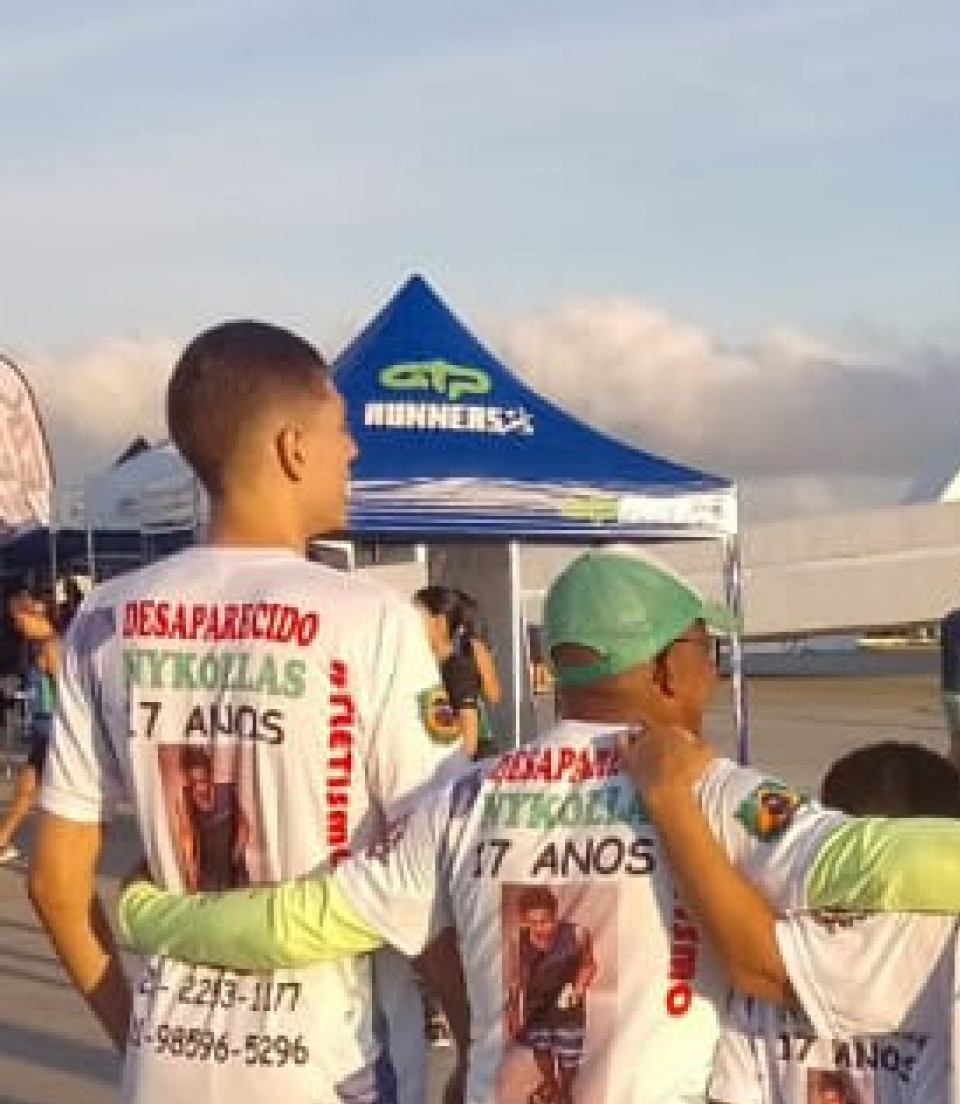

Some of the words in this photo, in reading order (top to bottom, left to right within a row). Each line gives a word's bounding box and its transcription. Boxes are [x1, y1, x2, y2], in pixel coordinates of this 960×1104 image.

[122, 599, 319, 647] DESAPARECIDO
[184, 704, 285, 745] ANOS
[530, 836, 657, 878] ANOS
